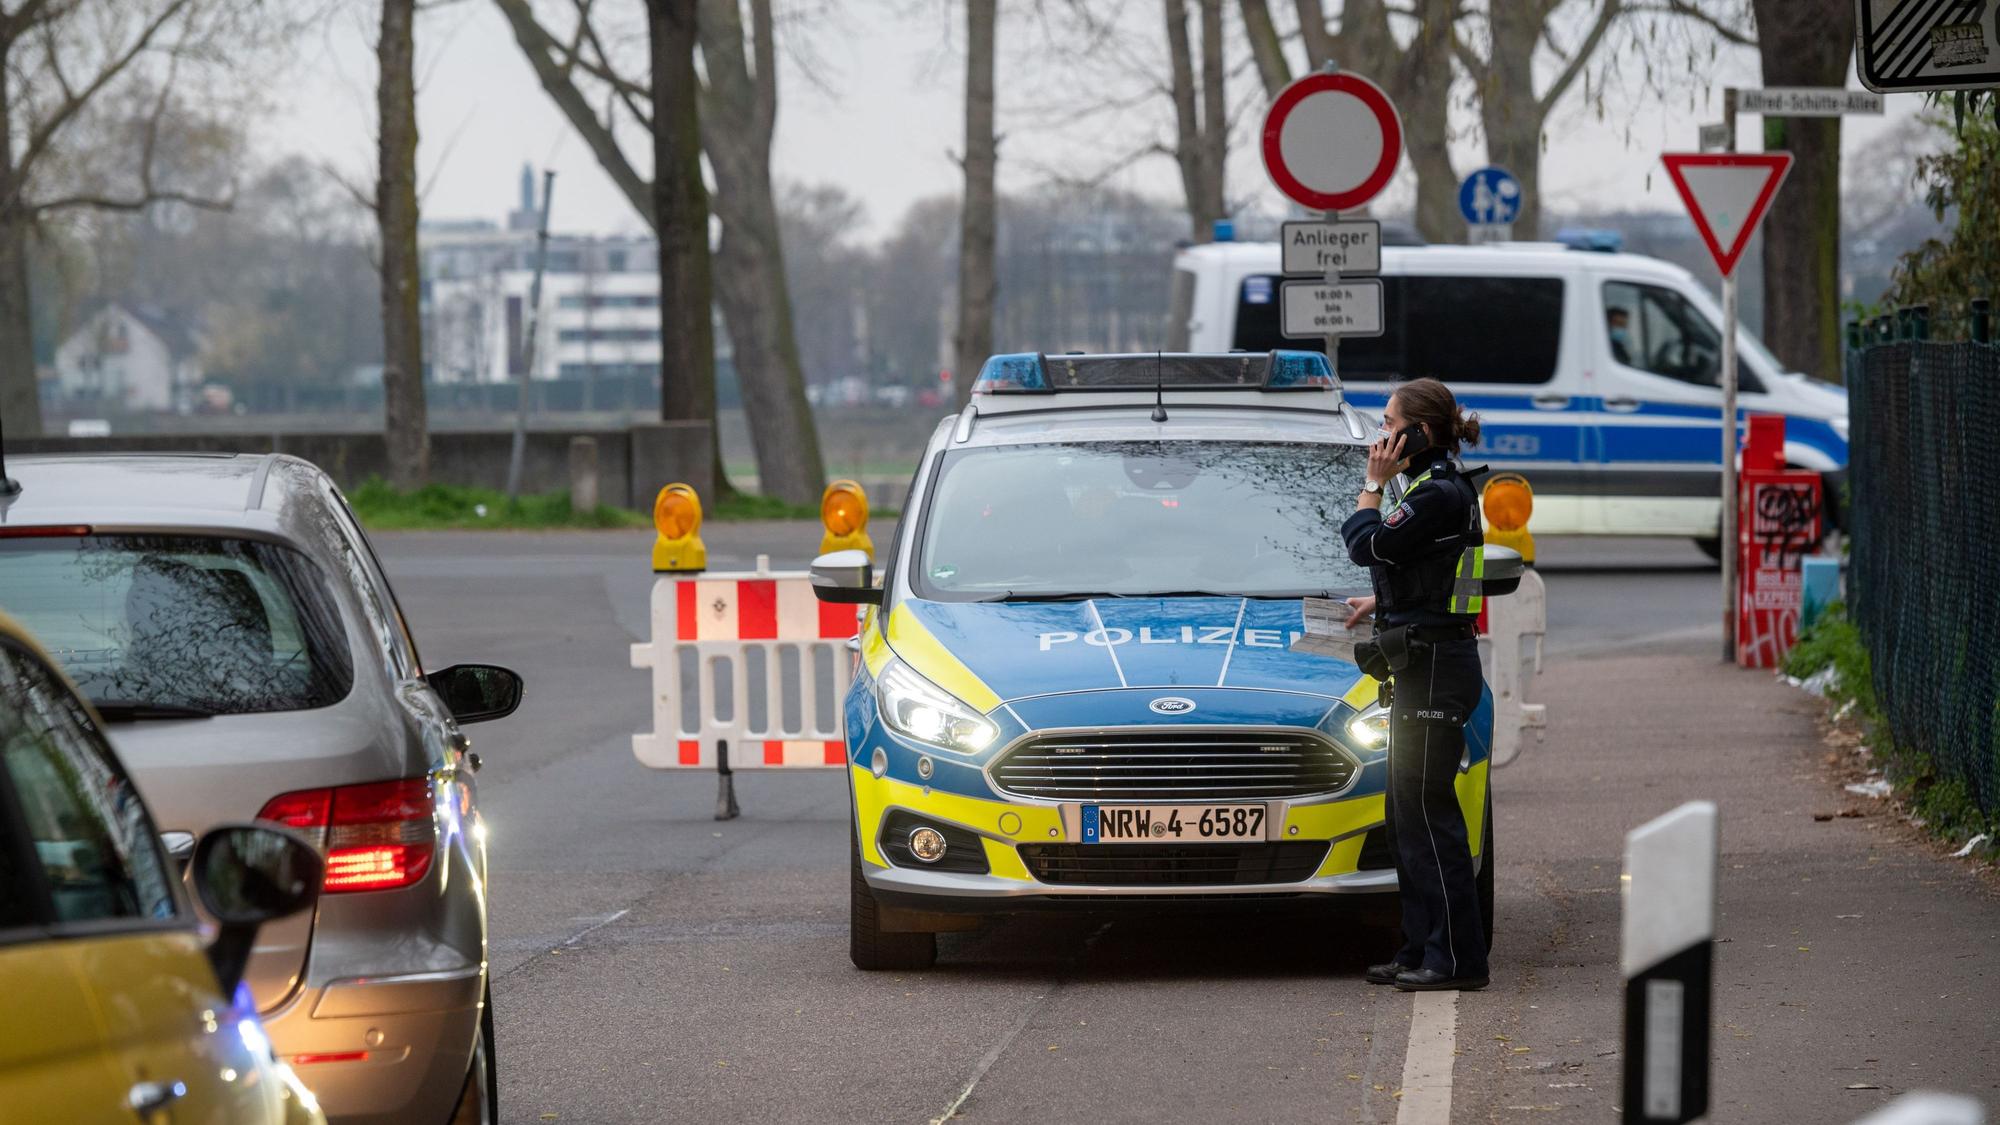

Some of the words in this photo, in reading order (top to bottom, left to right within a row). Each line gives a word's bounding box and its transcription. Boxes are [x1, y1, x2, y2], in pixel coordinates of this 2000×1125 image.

[1293, 229, 1369, 248] Anlieger
[1316, 251, 1347, 265] frei
[1325, 303, 1342, 313] bis
[1417, 710, 1444, 719] POLIZEI
[1100, 809, 1151, 838] NRW
[1168, 808, 1265, 837] 4-6587
[1087, 827, 1095, 837] D
